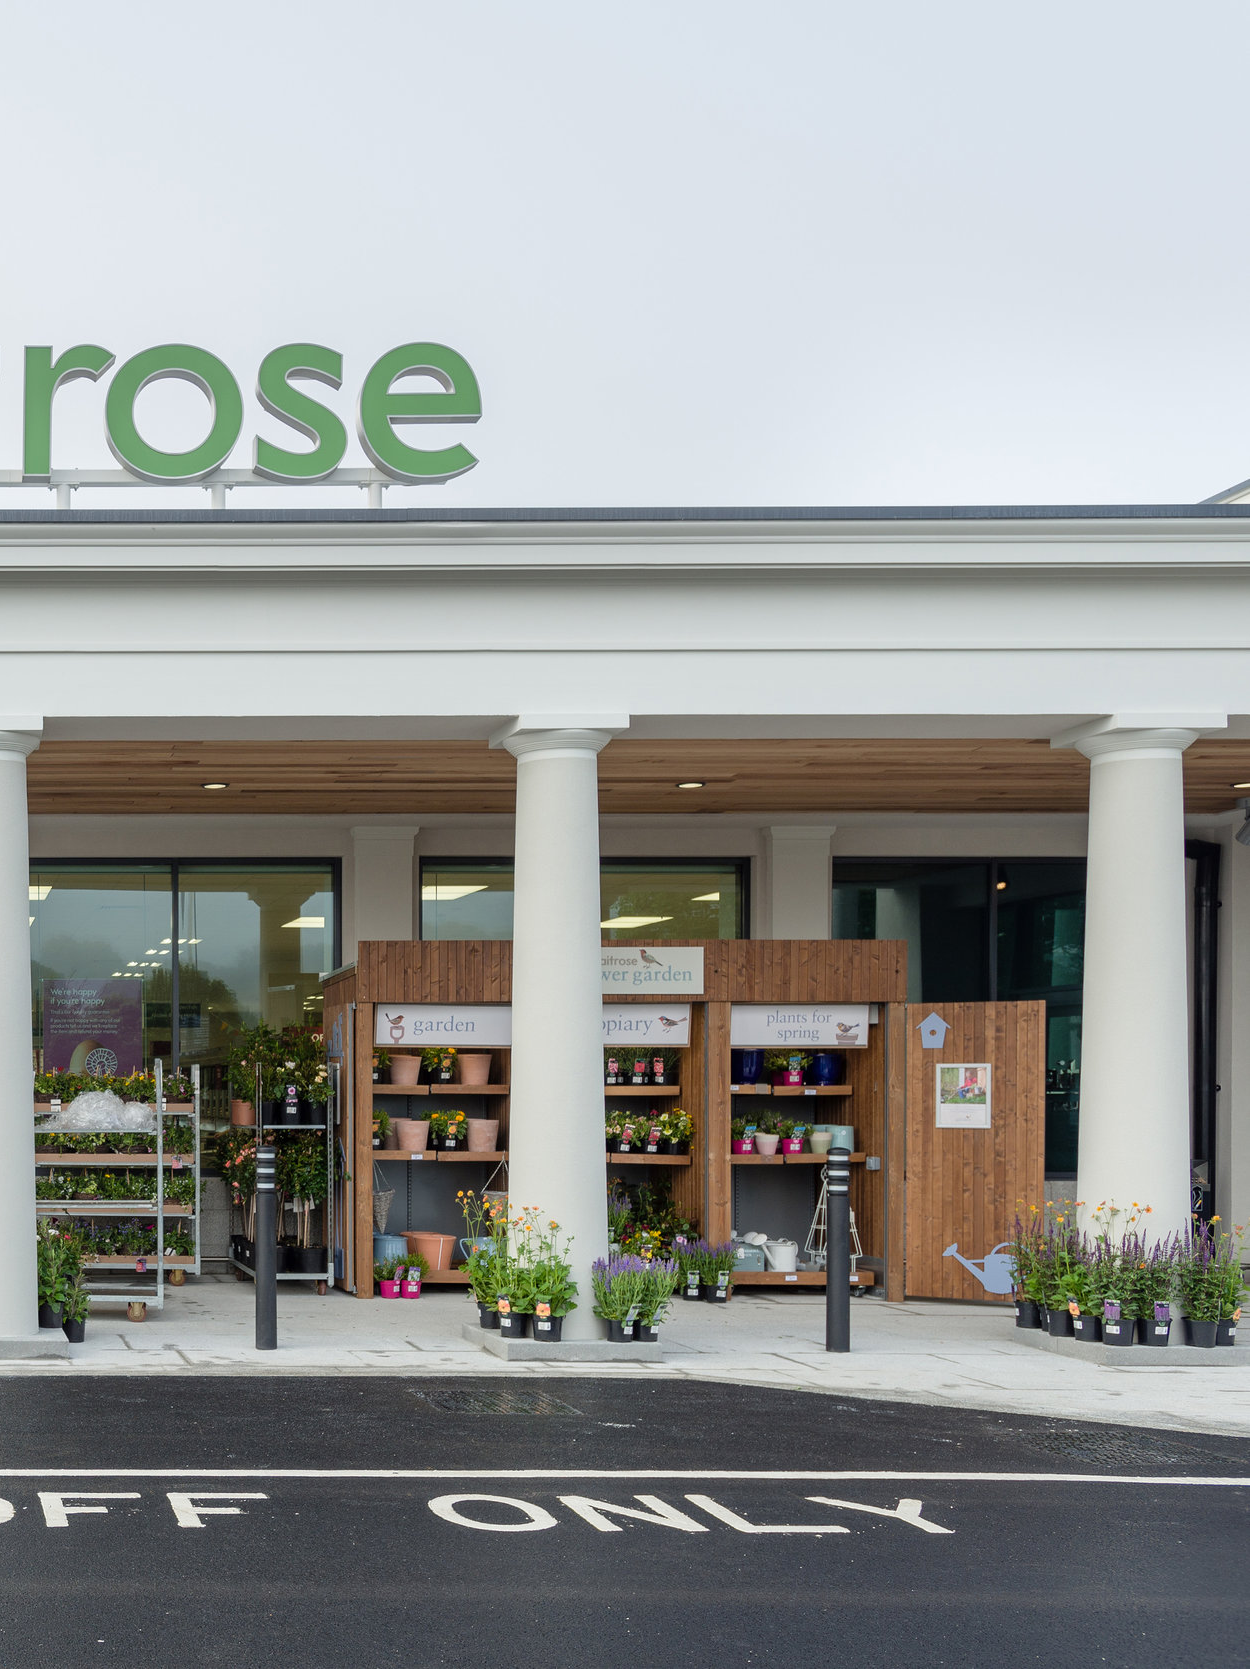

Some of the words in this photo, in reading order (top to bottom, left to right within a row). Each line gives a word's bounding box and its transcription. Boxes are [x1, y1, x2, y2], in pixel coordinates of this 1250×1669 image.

[632, 965, 692, 986] garden
[50, 988, 71, 996] We're
[73, 988, 98, 997] happy
[56, 998, 79, 1007] you're
[81, 998, 106, 1007] happy
[413, 1015, 476, 1036] garden
[602, 1014, 653, 1036] piary
[766, 1010, 807, 1026] plants
[811, 1009, 833, 1024] for
[777, 1026, 820, 1041] spring
[426, 1493, 957, 1533] ONLY
